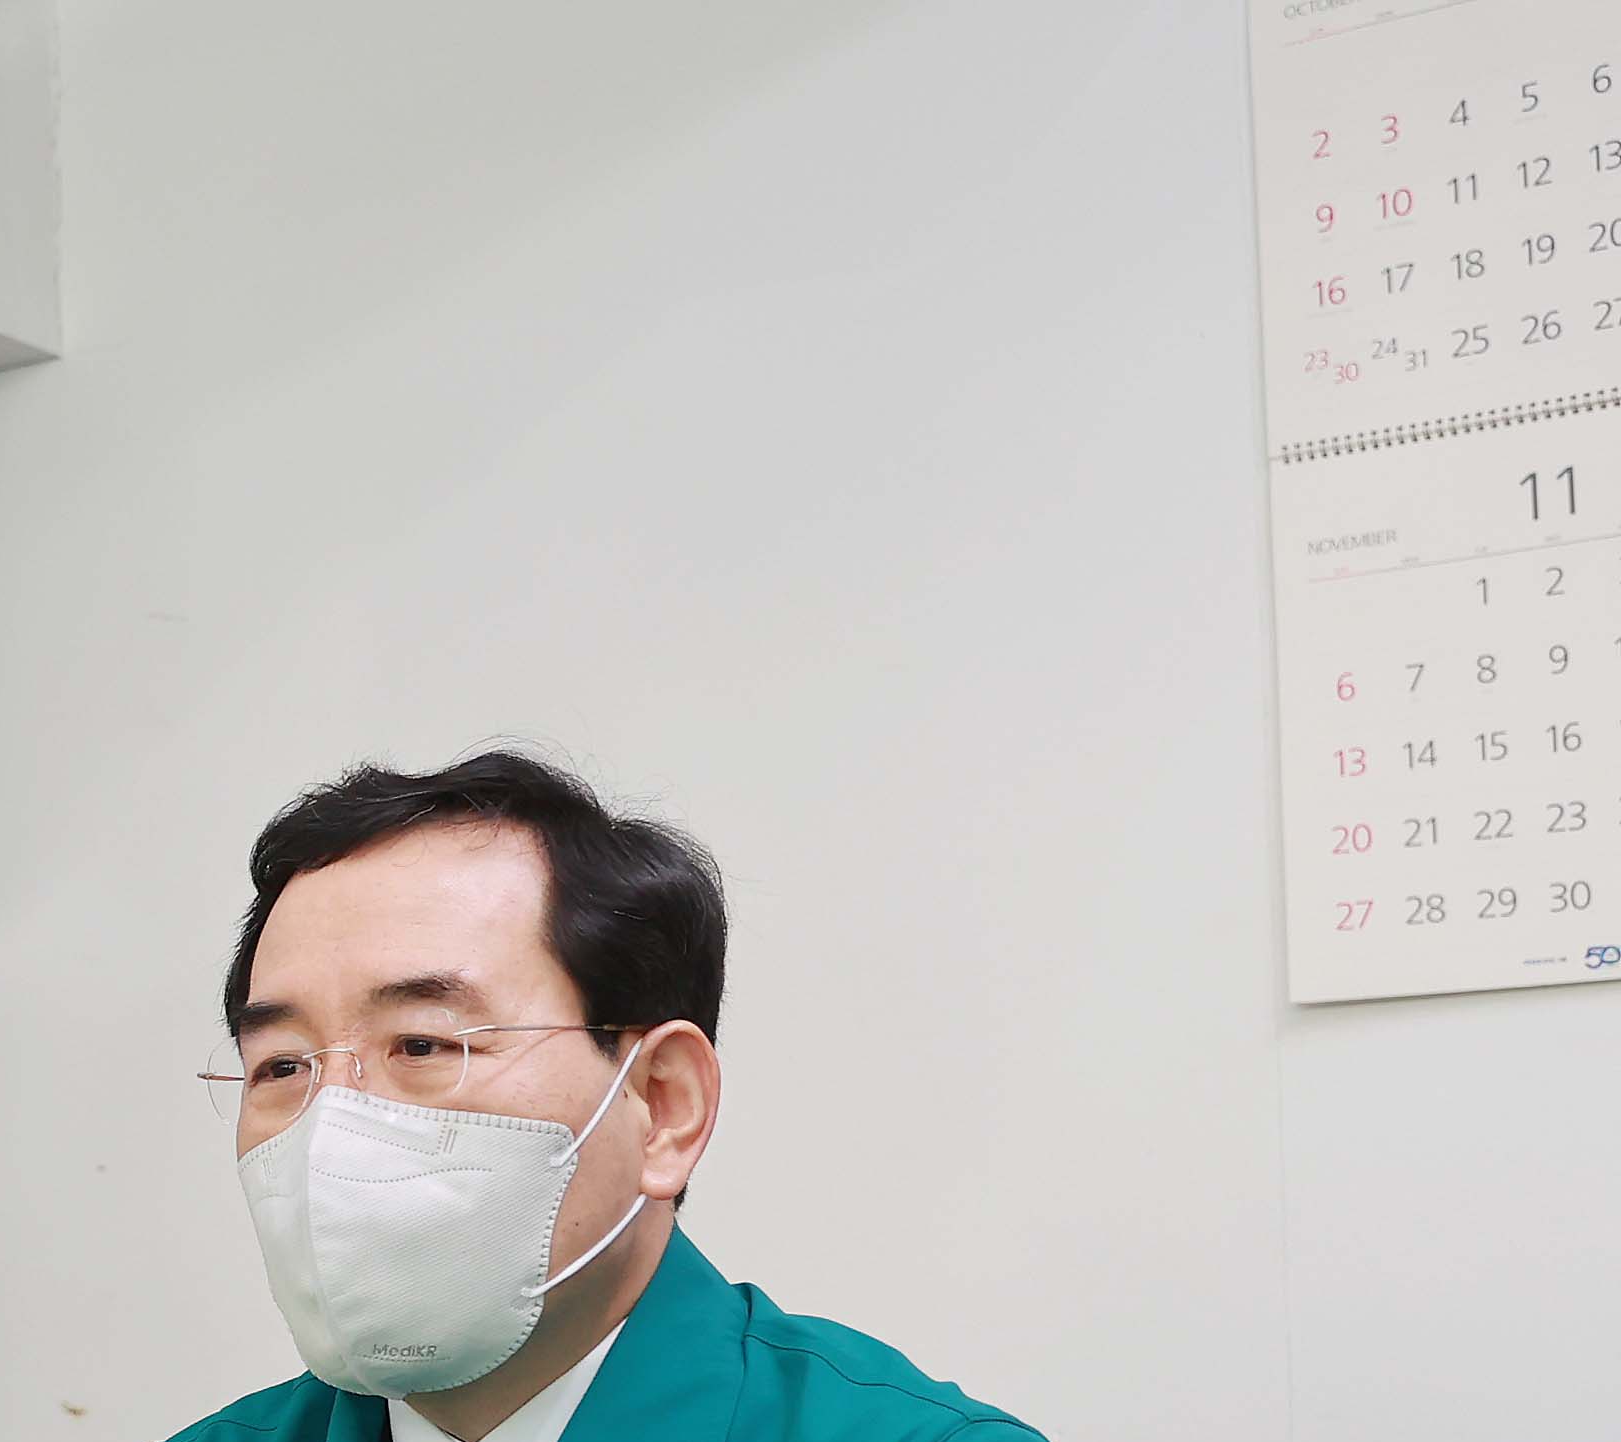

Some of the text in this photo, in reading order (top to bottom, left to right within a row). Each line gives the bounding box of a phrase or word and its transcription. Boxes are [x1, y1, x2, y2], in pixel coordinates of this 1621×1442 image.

[1312, 64, 1612, 160] 2 3 4 5 6
[1315, 205, 1334, 233] 9
[1376, 187, 1414, 219] 10
[1447, 173, 1479, 204] 11
[1517, 157, 1553, 188] 12
[1314, 234, 1555, 307] 16 17 18 19
[1303, 311, 1562, 384] 23 30 24 31 25 26
[1519, 465, 1578, 521] 11
[1307, 529, 1398, 557] NOVEMBER
[1476, 567, 1565, 605] 1 2
[1336, 645, 1569, 701] 6 7 8 9
[1333, 722, 1583, 778] 13 14 15 16
[1332, 802, 1587, 855] 20 21 22 23
[1335, 880, 1592, 931] 27 28 29 30
[372, 1343, 438, 1357] MediKR
